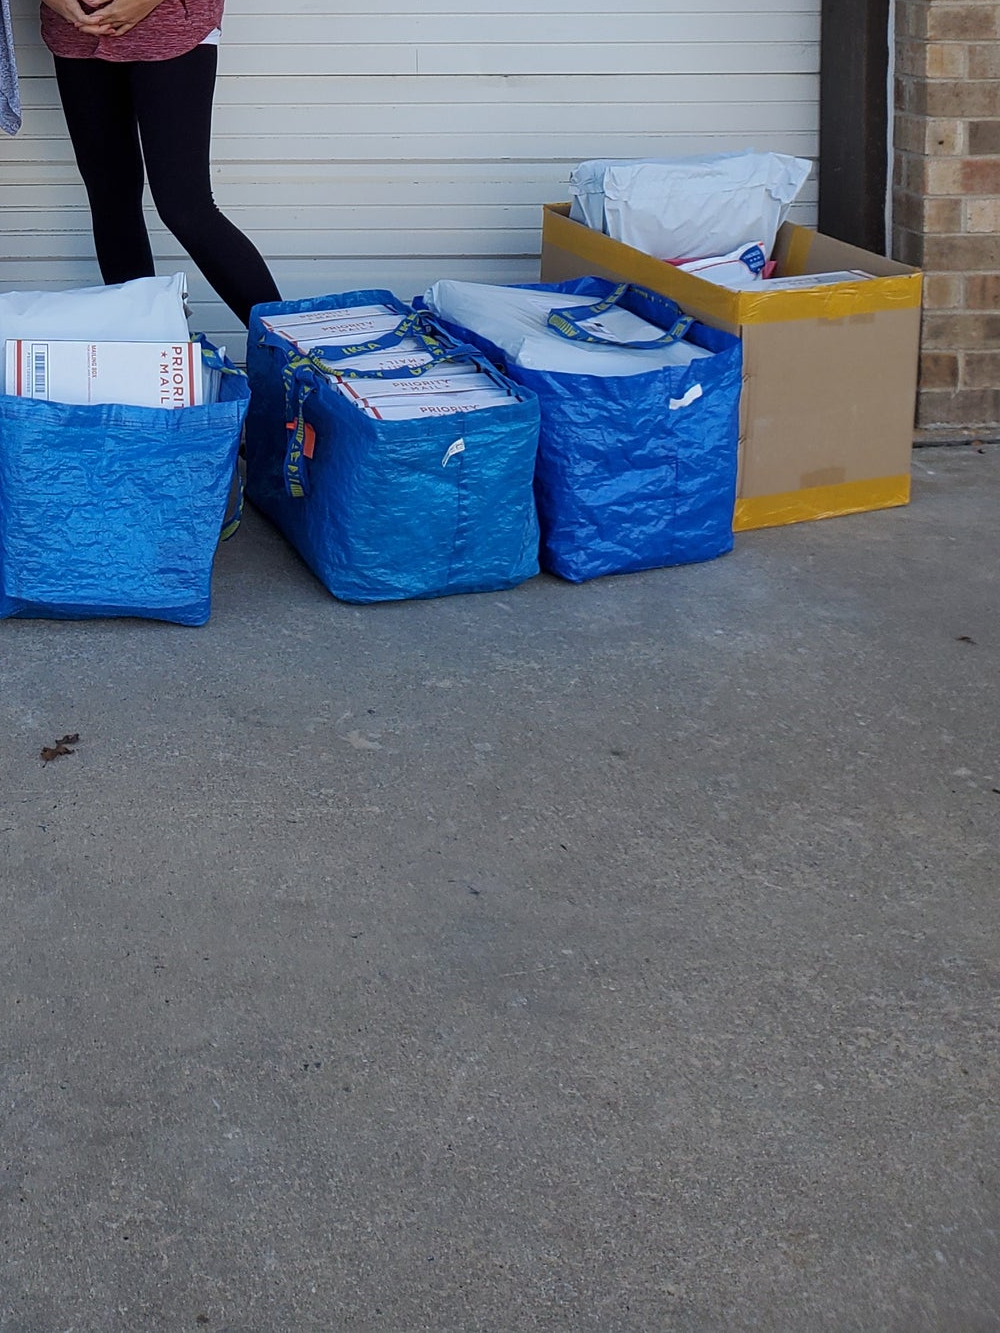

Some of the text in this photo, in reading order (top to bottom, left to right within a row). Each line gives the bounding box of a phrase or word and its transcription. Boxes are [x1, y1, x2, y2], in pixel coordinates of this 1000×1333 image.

[321, 321, 373, 331] PRIORITY
[341, 342, 382, 355] IKEA
[172, 346, 185, 409] PRIORIT
[159, 364, 170, 404] MAIL
[392, 379, 451, 388] PRIORITY
[419, 404, 480, 413] PRIORITY
